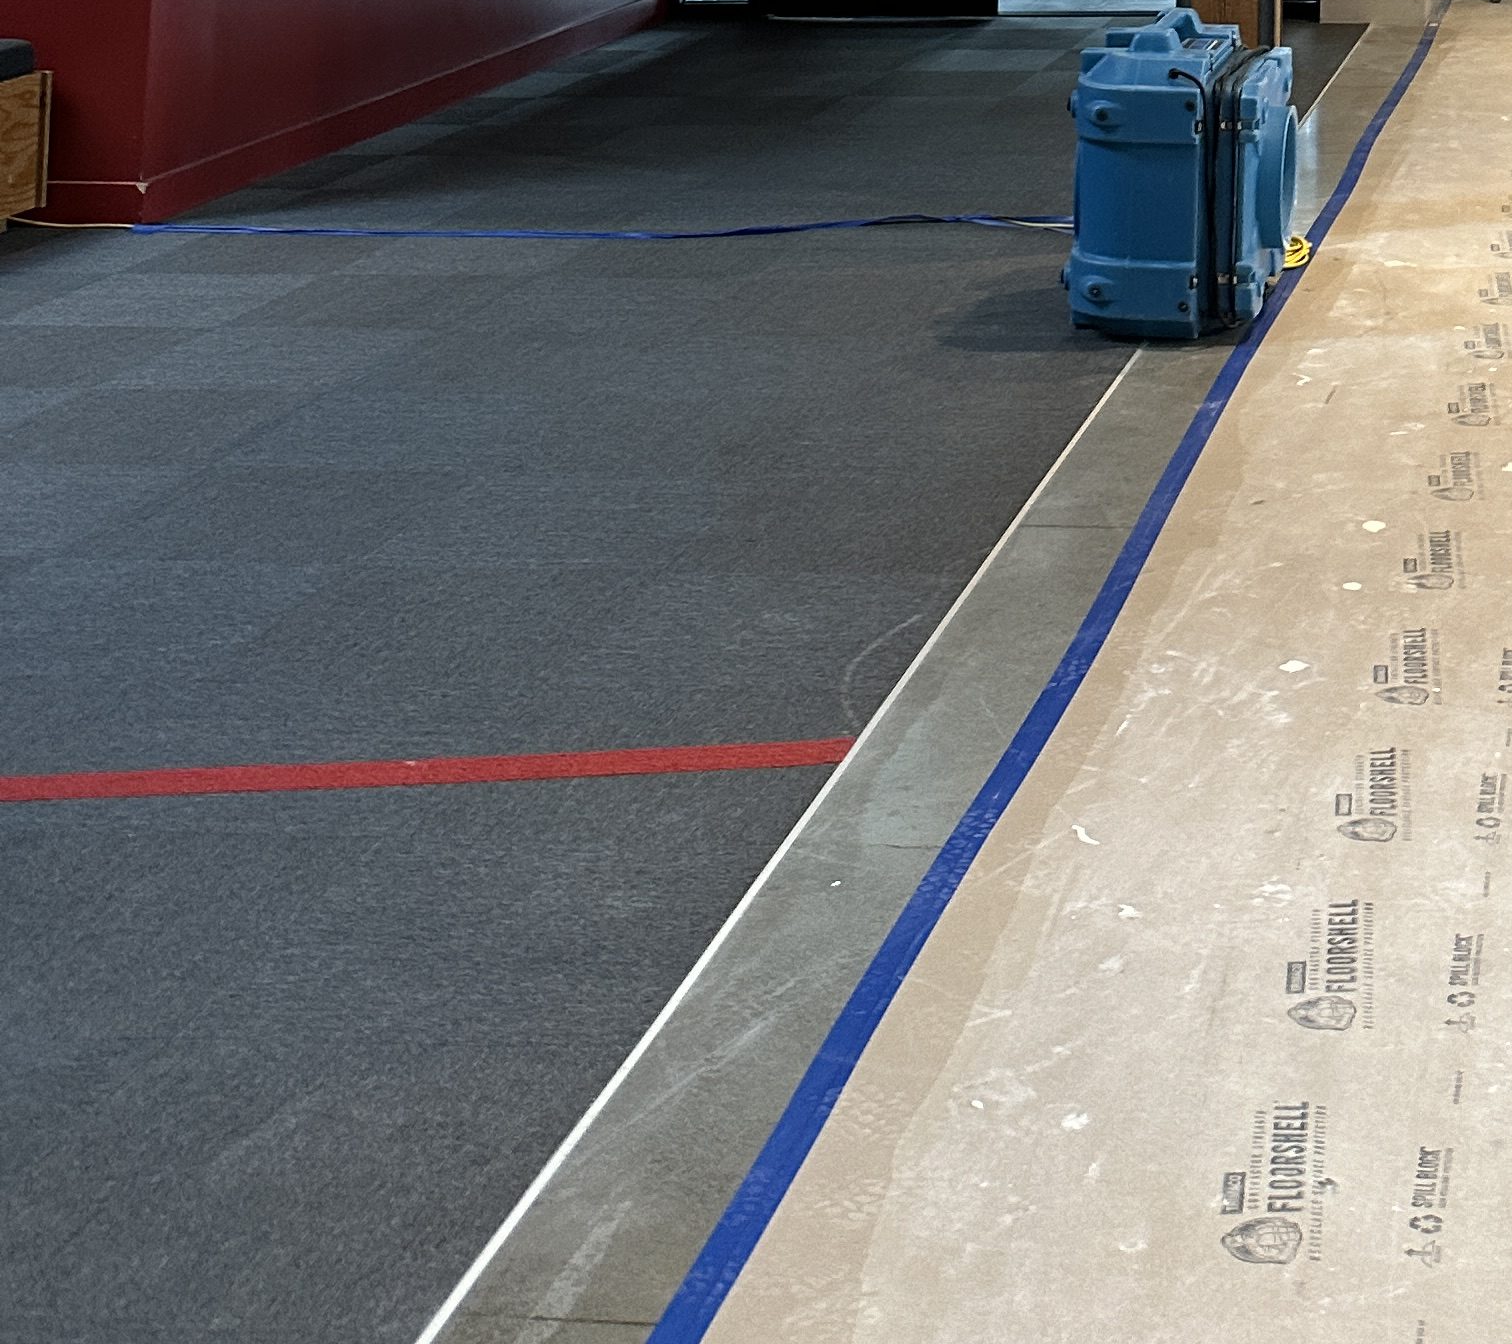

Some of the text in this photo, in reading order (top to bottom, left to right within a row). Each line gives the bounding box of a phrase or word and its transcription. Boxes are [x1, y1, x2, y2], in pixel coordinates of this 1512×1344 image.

[1368, 746, 1397, 817] FLOORSHELL
[1324, 899, 1360, 994] FLOORSHELL
[1266, 1102, 1310, 1213] FLOORSHELL
[1410, 1146, 1441, 1209] SPILL BLOCK
